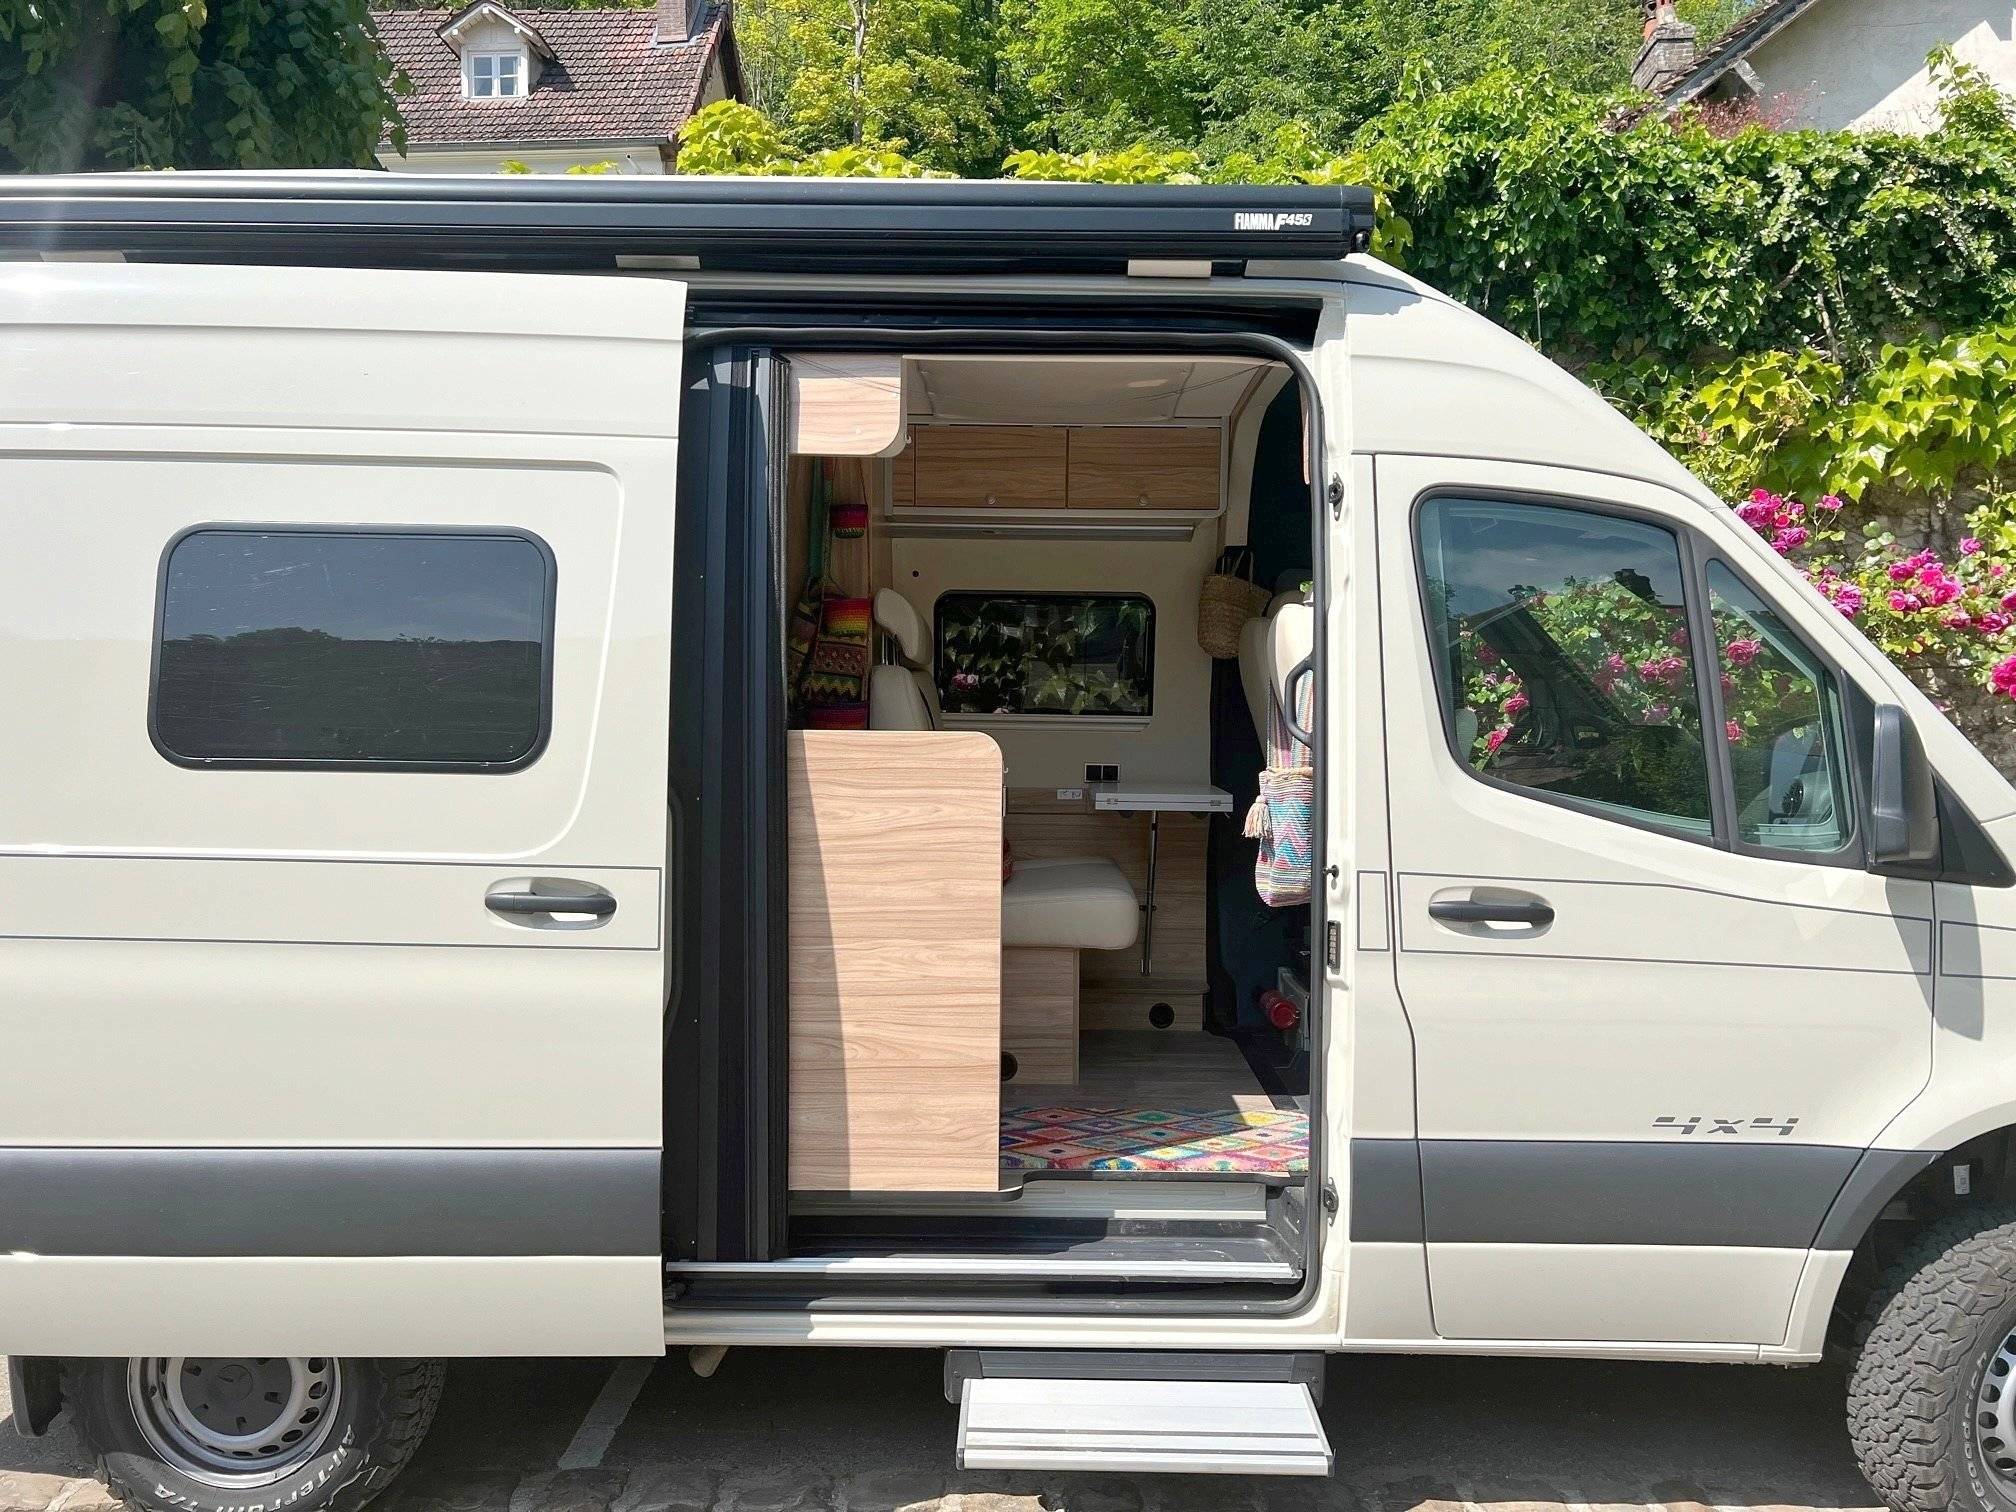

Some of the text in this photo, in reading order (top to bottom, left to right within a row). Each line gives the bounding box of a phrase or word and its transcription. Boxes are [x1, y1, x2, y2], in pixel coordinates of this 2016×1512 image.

[1234, 212, 1274, 230] FIAMMA
[1652, 1116, 1800, 1136] 4x4
[154, 1483, 199, 1512] T/A
